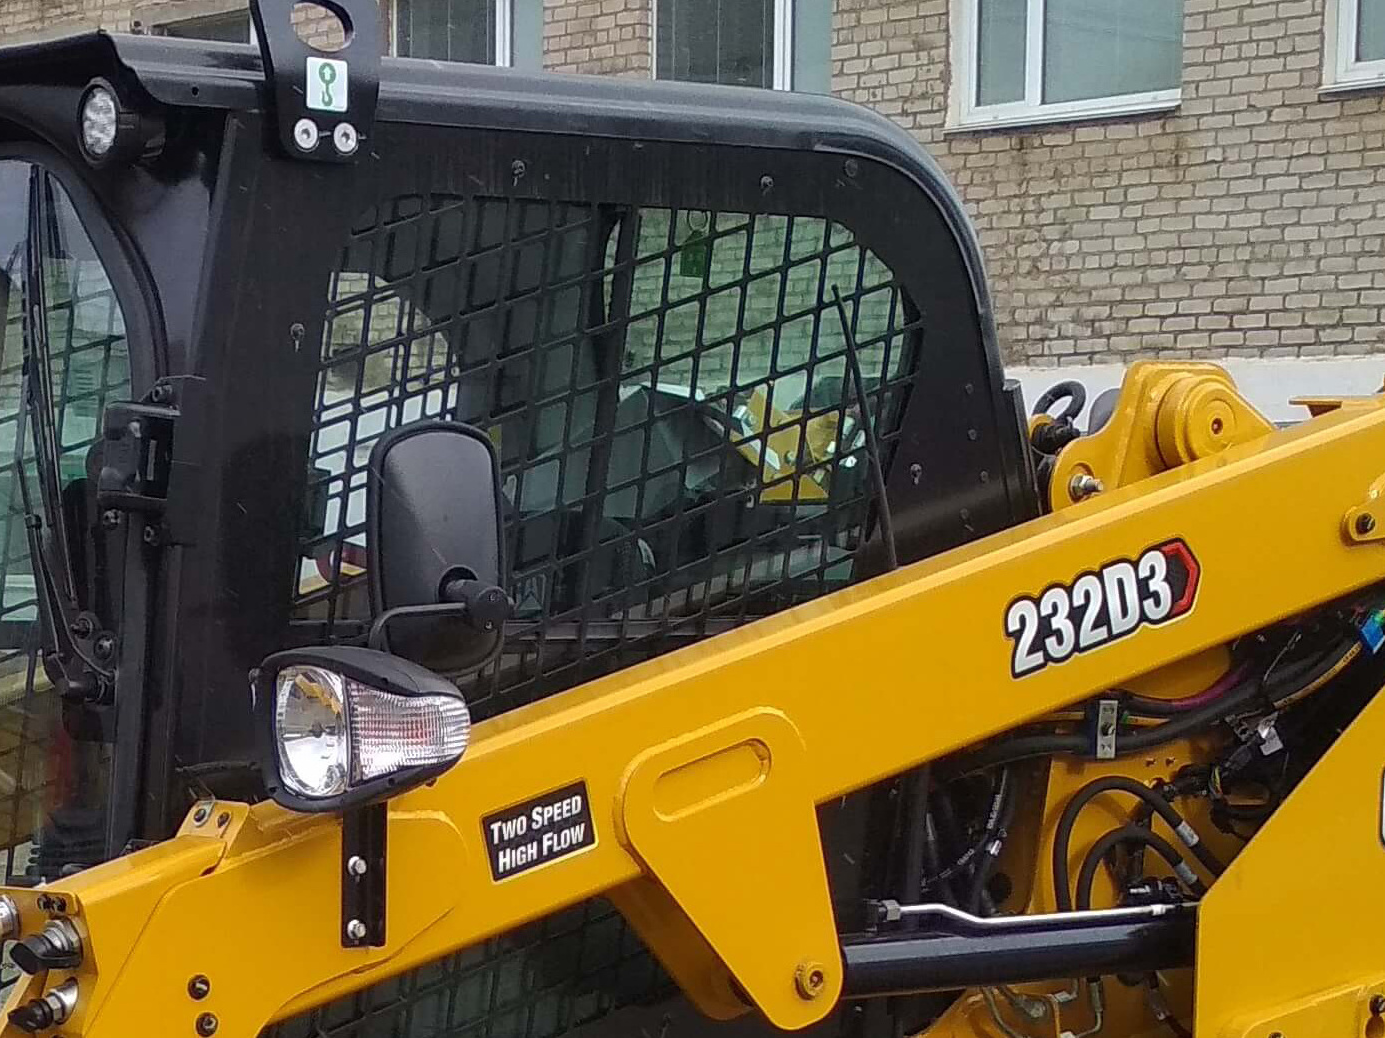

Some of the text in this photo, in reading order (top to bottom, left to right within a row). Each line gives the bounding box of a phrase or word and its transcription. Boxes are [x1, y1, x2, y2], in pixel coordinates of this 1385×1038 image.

[1007, 549, 1173, 674] 232D3
[490, 795, 583, 845] TWO SPEED
[498, 823, 586, 874] HIGH FLOW
